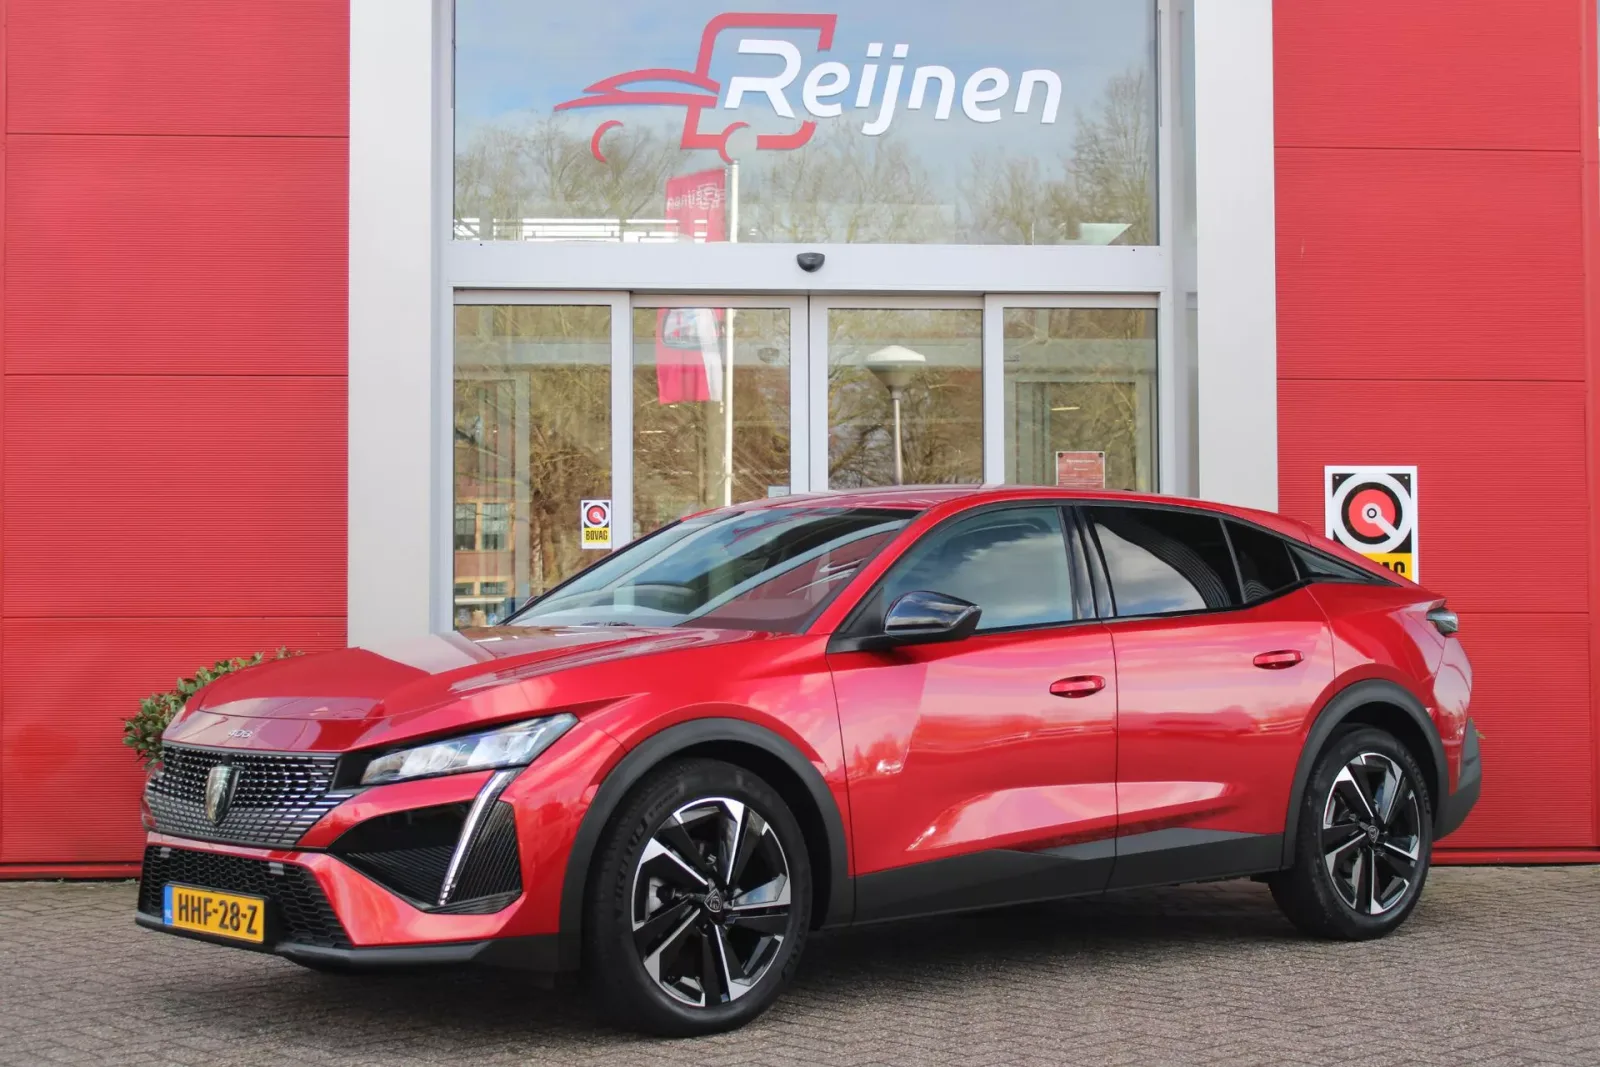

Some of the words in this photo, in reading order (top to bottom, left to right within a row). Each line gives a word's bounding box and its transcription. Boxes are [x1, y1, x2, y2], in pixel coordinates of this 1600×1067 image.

[724, 39, 1062, 136] Reijnen
[585, 530, 608, 541] BOVAG
[178, 893, 258, 935] HHF-28-Z
